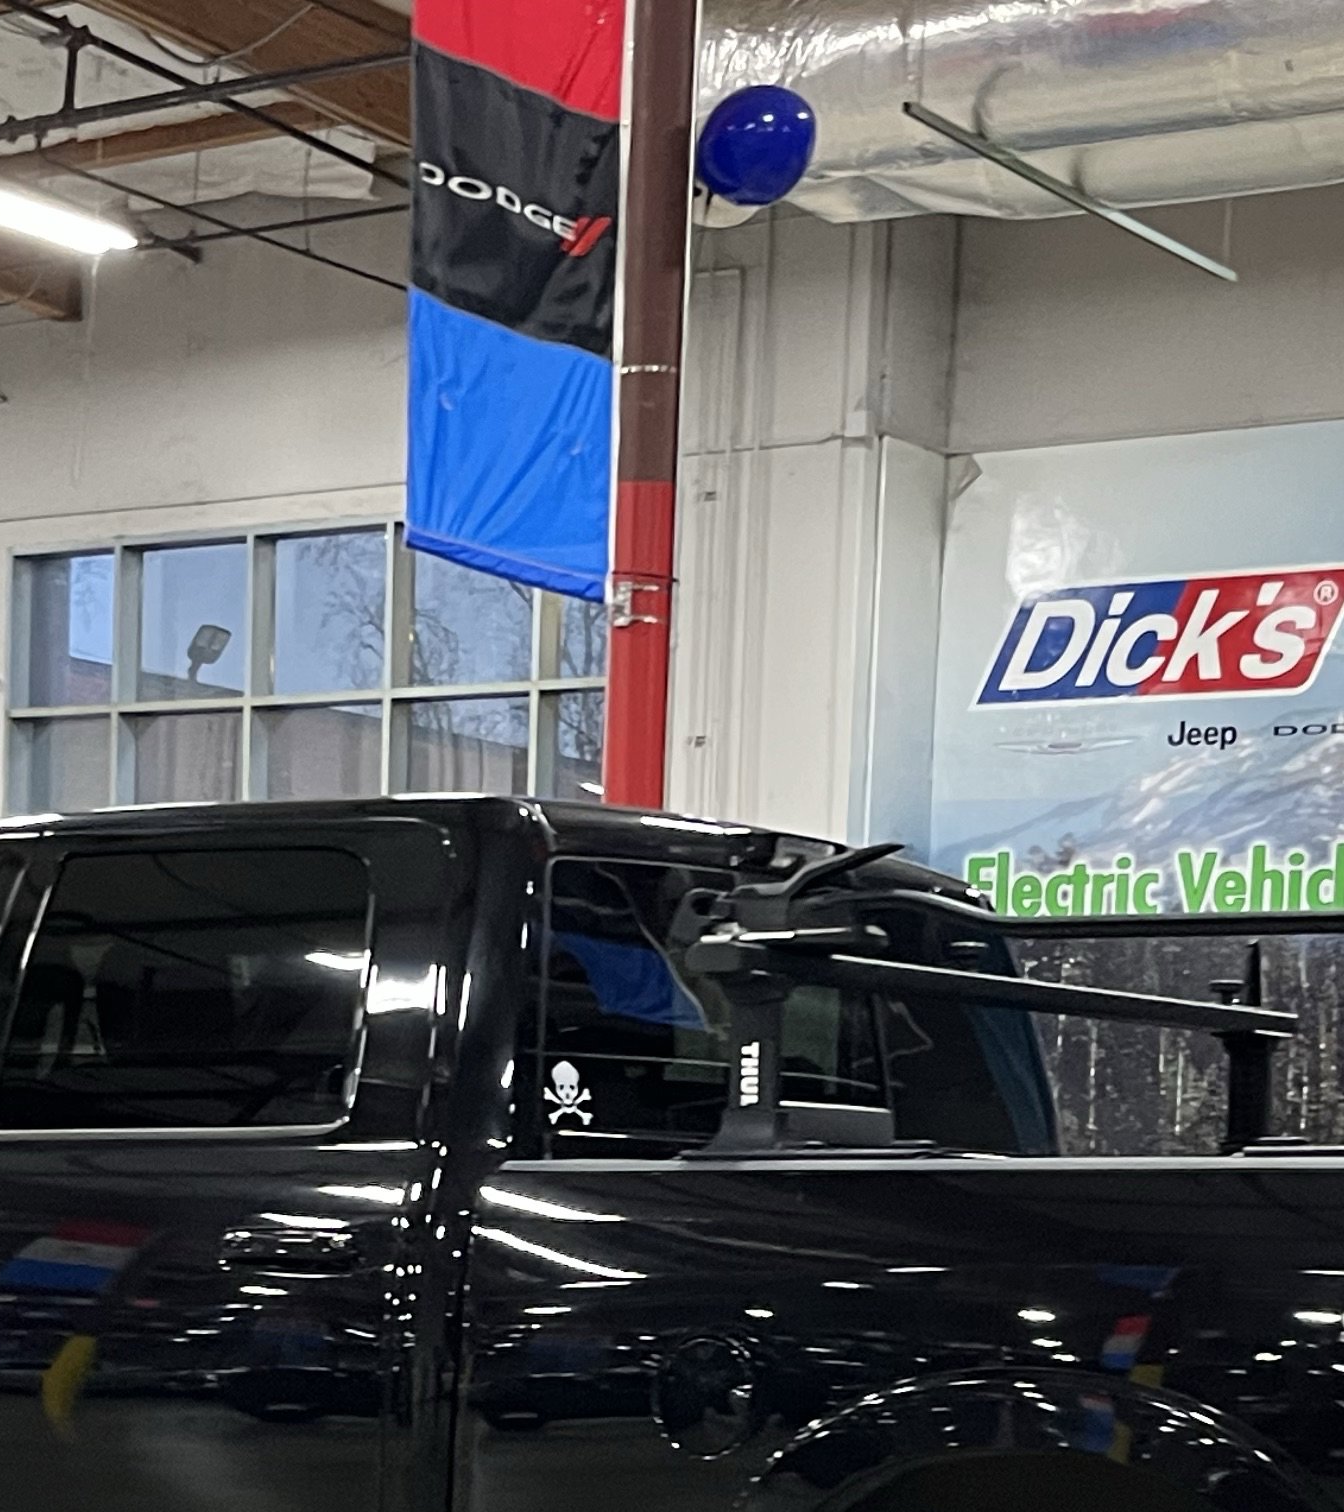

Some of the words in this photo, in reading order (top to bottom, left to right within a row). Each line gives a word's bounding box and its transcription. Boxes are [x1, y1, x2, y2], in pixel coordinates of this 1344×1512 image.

[419, 161, 578, 241] DODGE
[998, 581, 1317, 691] Dick's
[1167, 721, 1237, 750] Jeep
[968, 851, 1158, 916] Electric
[740, 1041, 760, 1107] THUL
